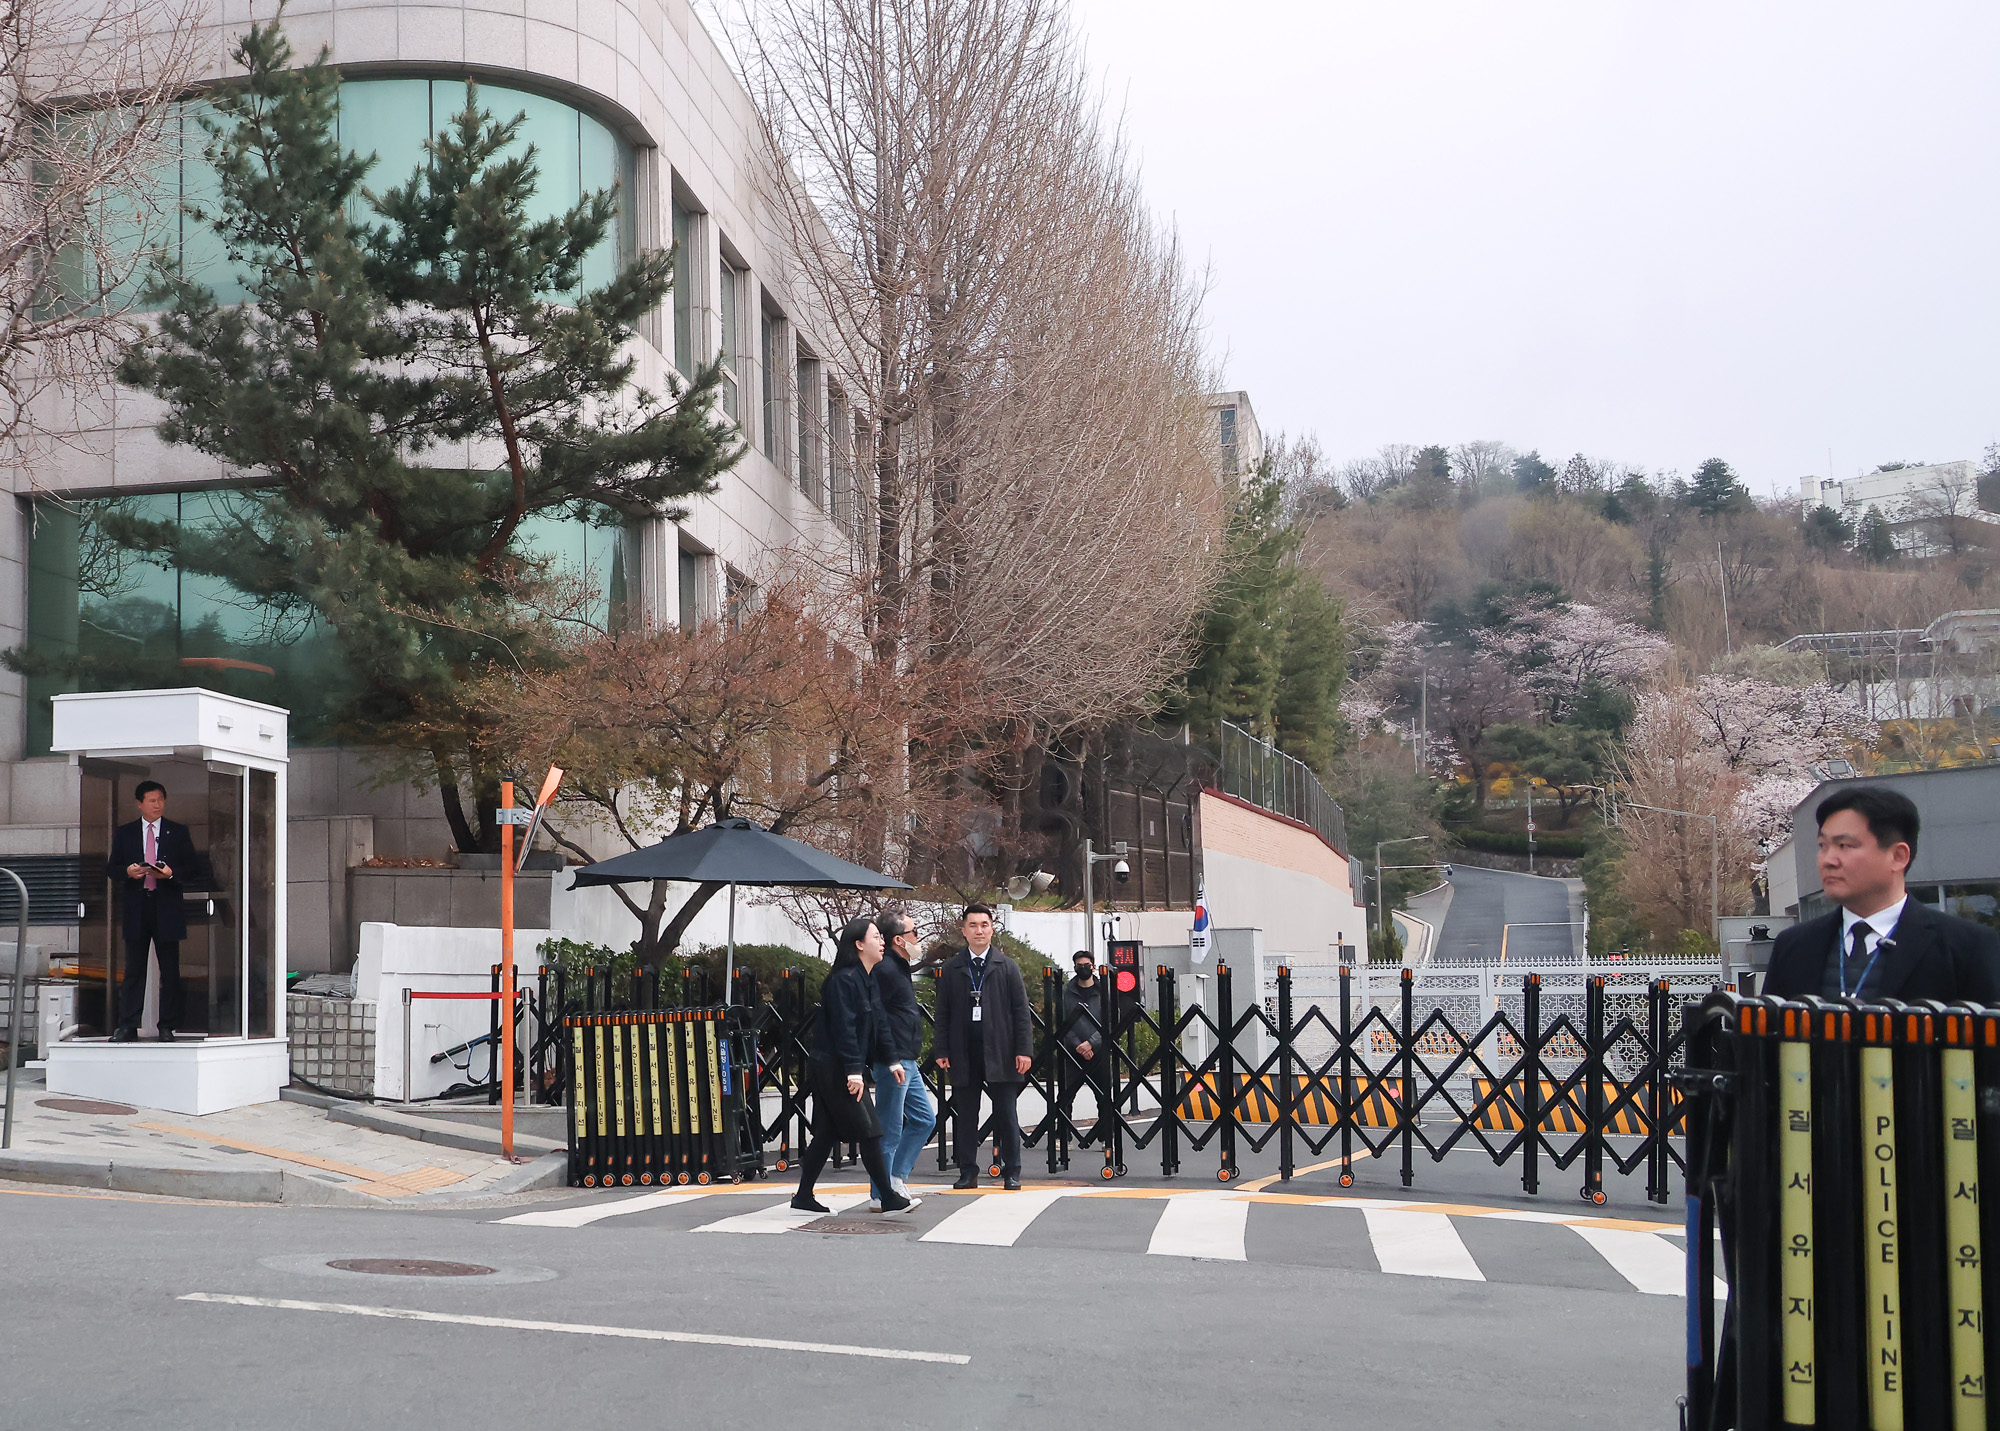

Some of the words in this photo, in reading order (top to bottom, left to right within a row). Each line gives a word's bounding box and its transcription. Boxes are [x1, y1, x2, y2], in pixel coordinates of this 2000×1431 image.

[575, 1046, 584, 1126] 질서유지선
[614, 1045, 623, 1125] 질서유지선
[649, 1043, 660, 1123] 질서유지선
[686, 1042, 698, 1122] 질서유지선
[707, 1041, 715, 1084] POLICE
[1874, 1115, 1895, 1264] POLICE
[1787, 1109, 1812, 1384] 질서유지선
[1950, 1117, 1985, 1398] 질서유지선
[1882, 1294, 1897, 1392] LINE
